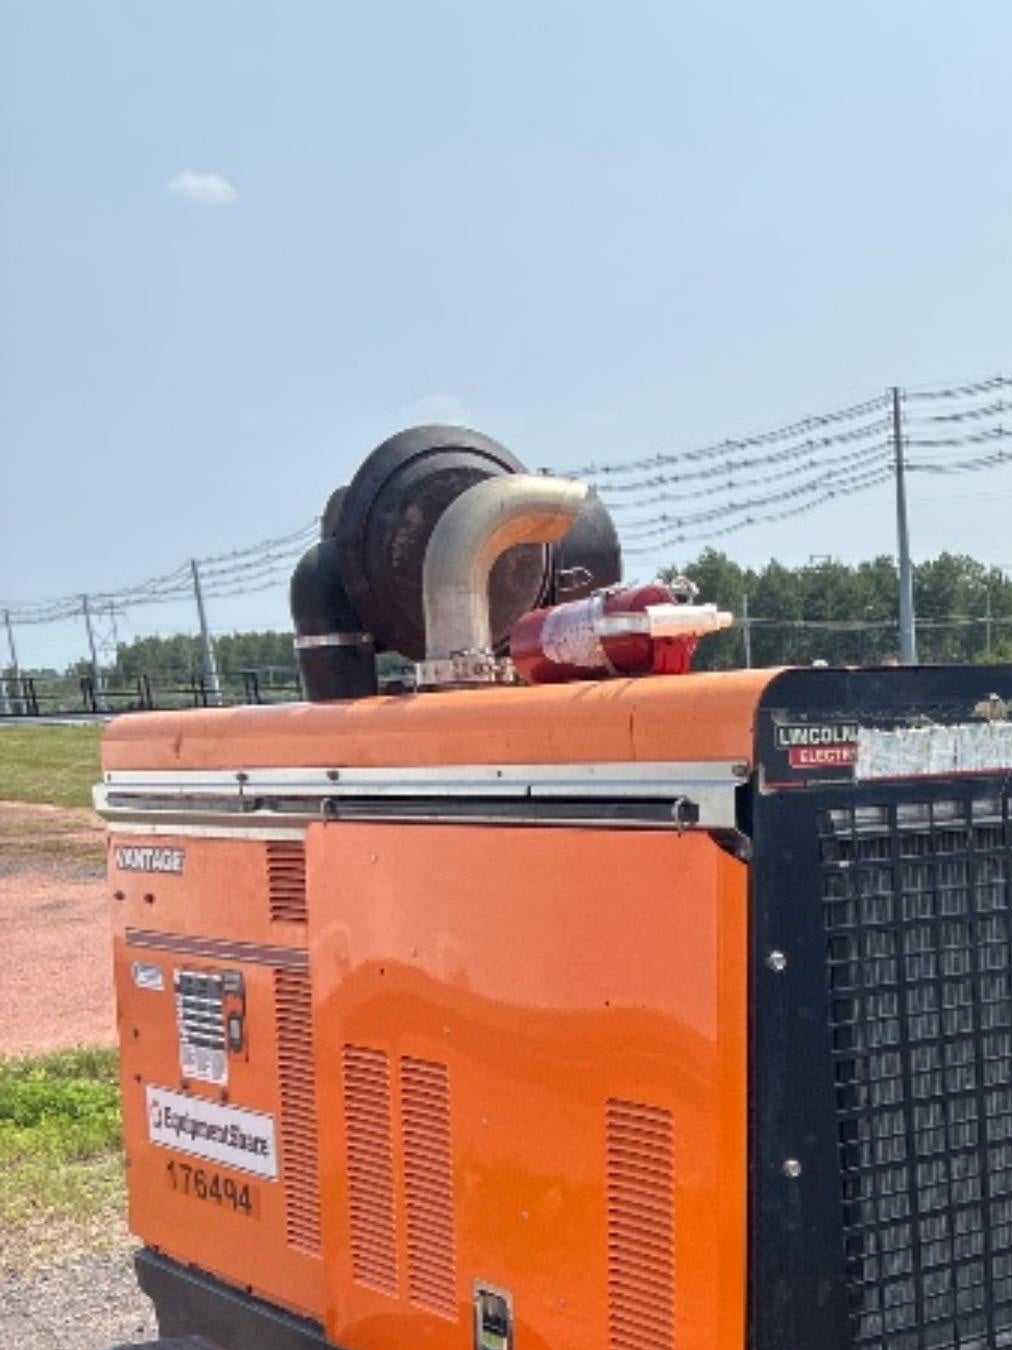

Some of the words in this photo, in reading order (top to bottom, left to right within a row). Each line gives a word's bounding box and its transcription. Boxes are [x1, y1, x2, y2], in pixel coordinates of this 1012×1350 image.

[116, 847, 184, 872] VANTAGE
[164, 1106, 270, 1157] EquipmentShare
[167, 1160, 253, 1215] 176494
